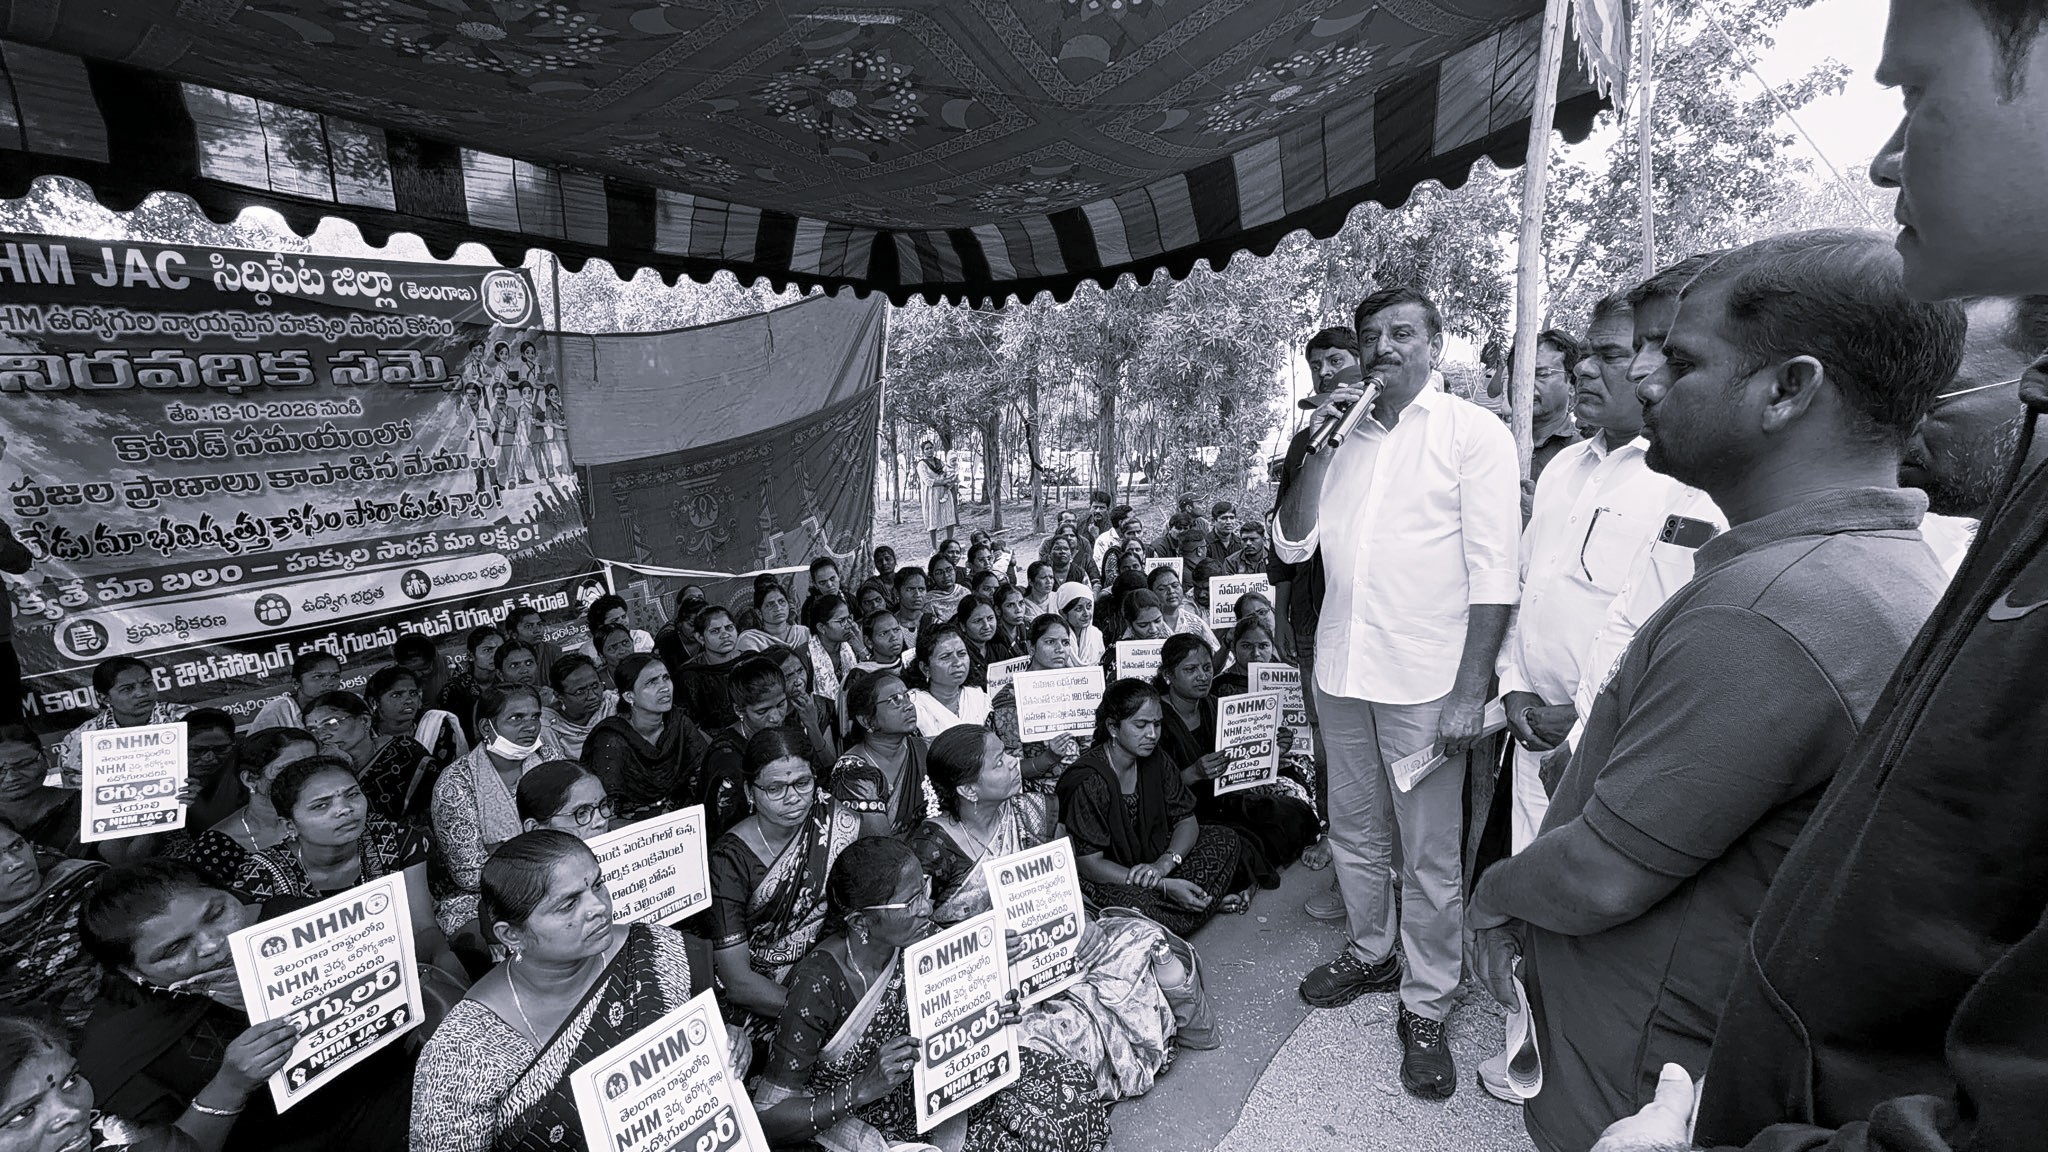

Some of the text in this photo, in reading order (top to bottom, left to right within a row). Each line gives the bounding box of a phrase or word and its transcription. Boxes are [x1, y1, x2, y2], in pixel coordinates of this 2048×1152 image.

[0, 242, 76, 286] HM
[91, 246, 190, 290] JAC
[331, 267, 398, 309] జిల్లా
[399, 281, 478, 302] (తెలంగాణ)
[494, 280, 518, 289] NHM
[0, 306, 453, 341] HM ఉద్యోగుల న్యాయమైన హక్కుల సాధన కోసం
[0, 349, 463, 394] నిరవధిక సమ్మె
[320, 398, 362, 416] నుండి
[114, 419, 412, 461] కోవిడ్ సమయంలో
[8, 476, 115, 517] ప్రజల
[123, 470, 262, 510] ప్రాణాలు
[268, 451, 398, 490] కాపాడిన
[17, 521, 91, 560] నేడు
[94, 521, 143, 554] మా
[16, 578, 89, 620] క్యతే
[96, 577, 154, 601] మా
[161, 564, 243, 592] బలం
[285, 547, 370, 574] హక్కుల
[376, 532, 440, 560] సాధనే
[443, 531, 476, 551] మా
[301, 594, 349, 614] ఉద్యోగ
[350, 586, 386, 606] భద్రత
[432, 571, 479, 588] కుటుంబ
[480, 564, 508, 579] భద్రత
[1005, 661, 1029, 674] NHM
[1272, 671, 1298, 681] NHM
[1071, 692, 1081, 700] 180
[1237, 699, 1264, 713] NHM
[116, 733, 158, 748] NHM
[1223, 726, 1241, 736] NHM
[96, 763, 125, 774] NHM
[1228, 772, 1244, 780] NHM
[98, 778, 173, 800] రెగ్యులర్
[109, 811, 162, 825] NHM JAC
[112, 801, 159, 813] చేయాలి
[1015, 855, 1053, 881] NHM
[612, 902, 630, 920] టనే
[660, 896, 689, 916] DISTRICT
[1006, 900, 1034, 919] NHM
[291, 901, 364, 947] NHM
[274, 948, 328, 976] తెలంగాణ
[936, 931, 977, 968] NHM
[1032, 946, 1067, 969] చేయాలి
[267, 966, 318, 1000] NHM
[323, 958, 345, 977] వైద్య
[291, 955, 384, 1005] ఉద్యోగులందరిని
[924, 973, 956, 994] తెలంగాణ
[1032, 968, 1052, 985] NHM
[1054, 960, 1071, 974] JAC
[920, 990, 950, 1018] NHM
[309, 1004, 379, 1047] చేయాలి
[928, 1002, 998, 1059] రెగ్యులర్
[310, 1017, 386, 1067] NHM JAC
[629, 1028, 689, 1086] NHM
[945, 1044, 989, 1077] చేయాలి
[943, 1060, 994, 1097] NHM JAC
[619, 1087, 665, 1122] తెలంగాణ
[616, 1108, 661, 1151] NHM
[663, 1099, 684, 1123] వైద్య
